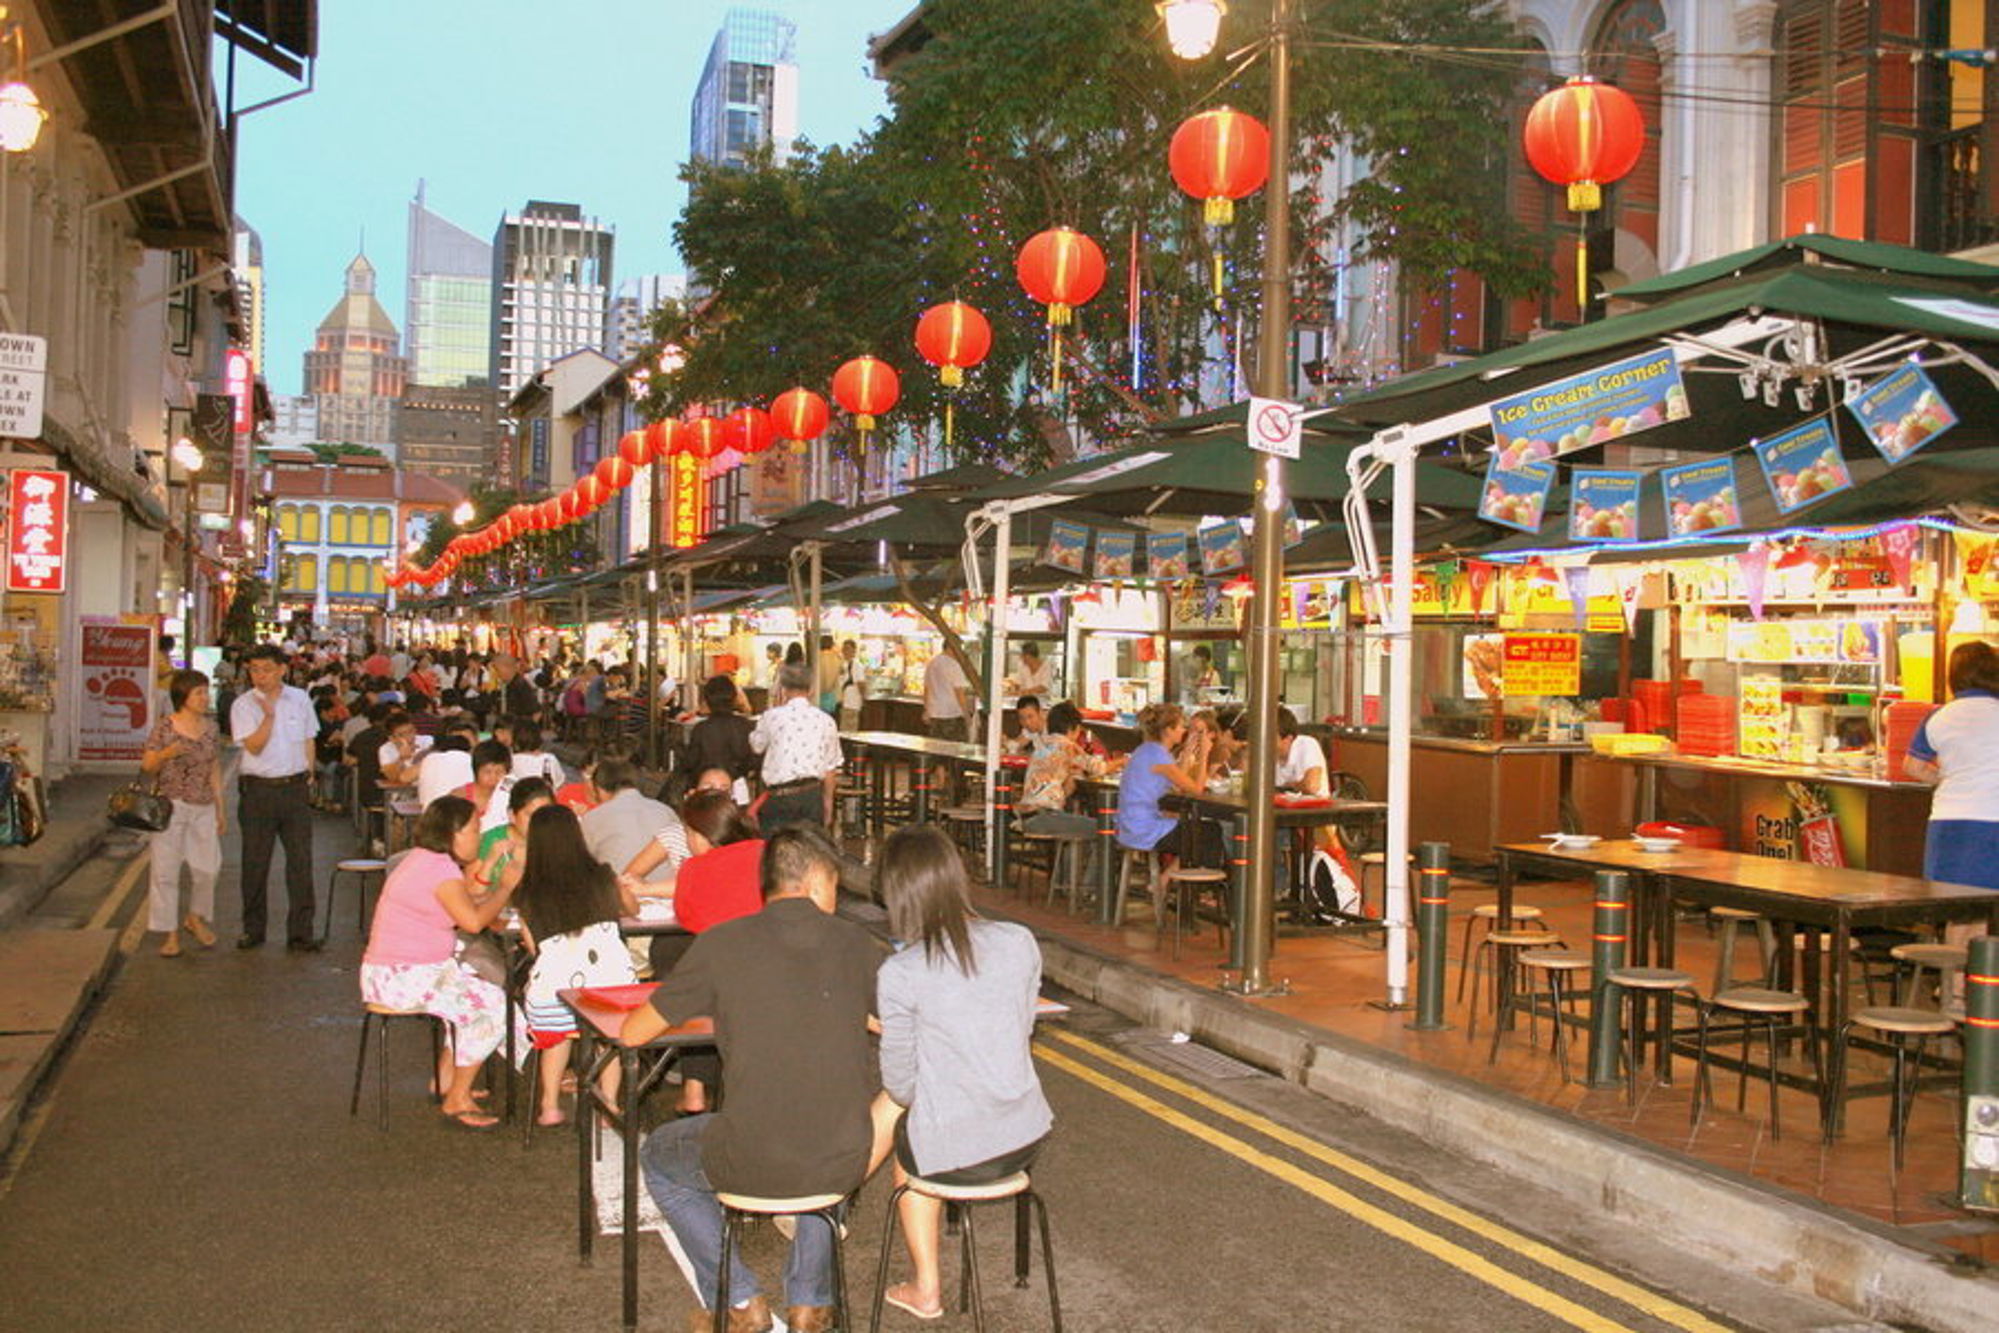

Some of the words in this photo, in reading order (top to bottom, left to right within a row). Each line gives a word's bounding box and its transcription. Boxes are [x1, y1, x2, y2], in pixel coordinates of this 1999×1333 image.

[1497, 403, 1528, 425] Ice
[1530, 382, 1594, 413] Cream
[1598, 358, 1672, 393] Corner
[1756, 814, 1793, 840] Grab
[1756, 840, 1793, 860] One!
